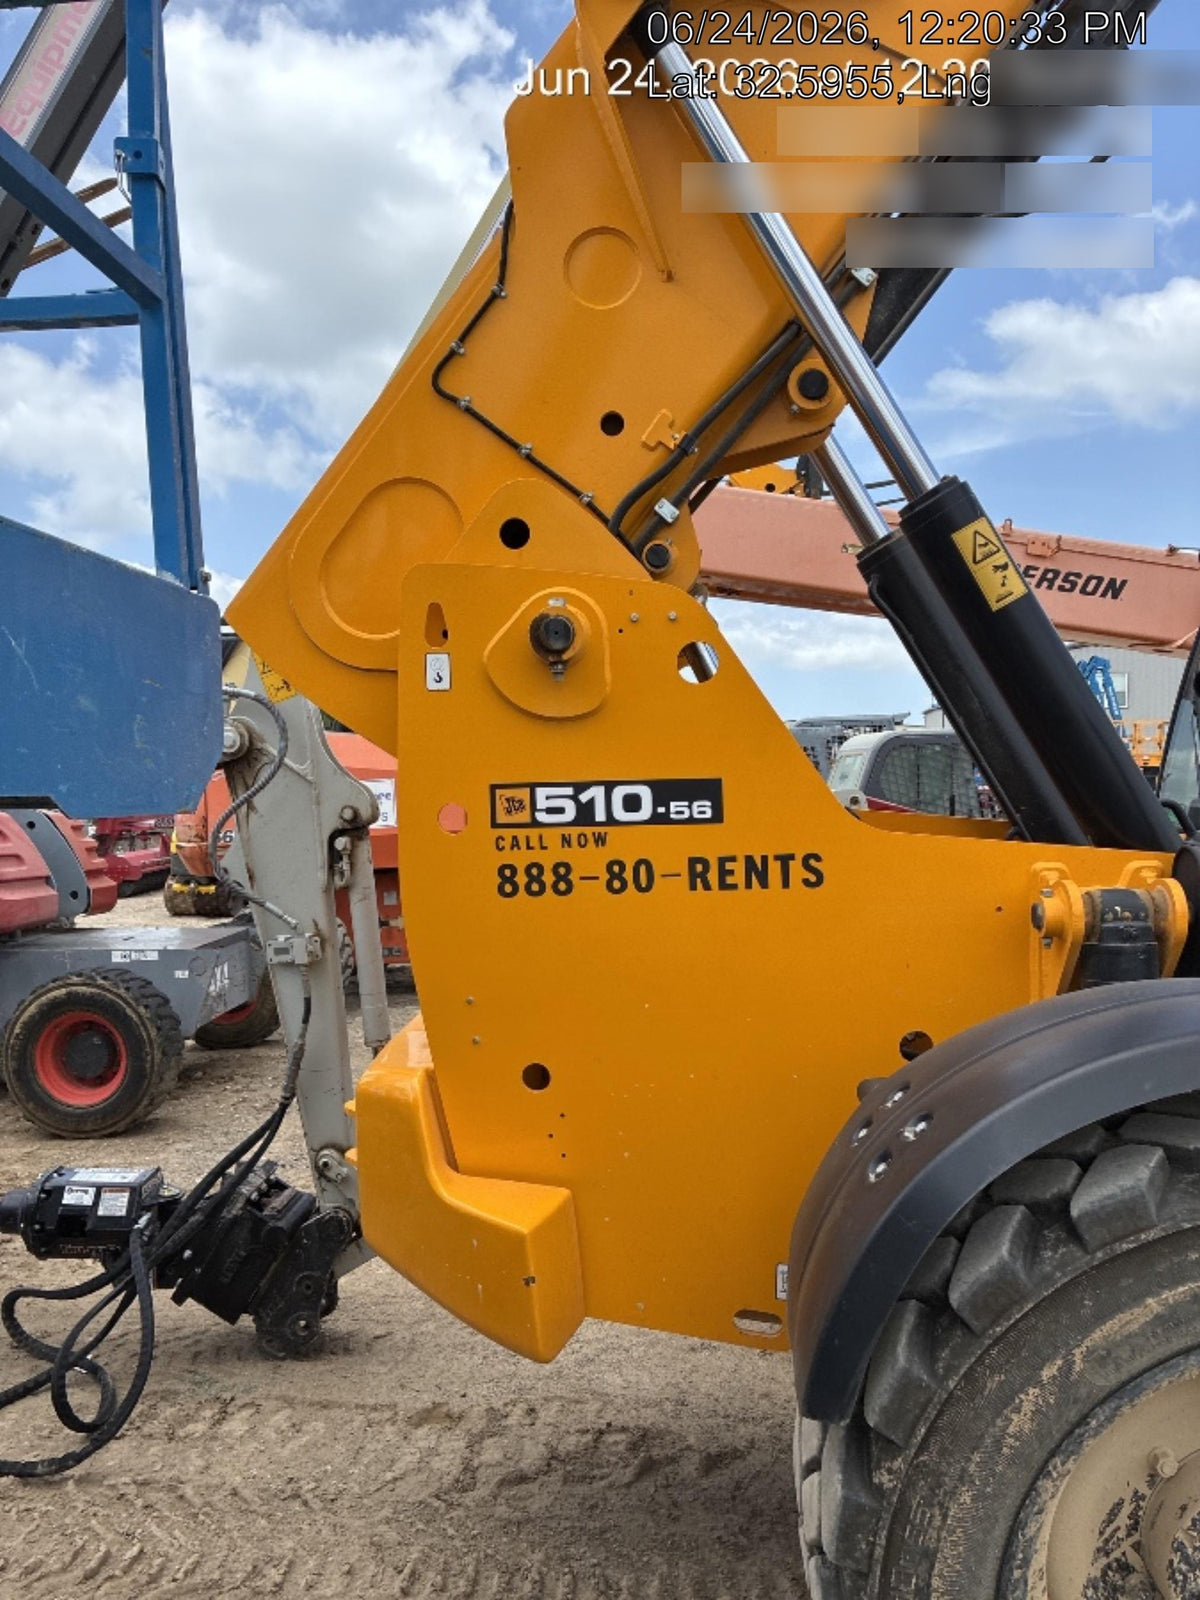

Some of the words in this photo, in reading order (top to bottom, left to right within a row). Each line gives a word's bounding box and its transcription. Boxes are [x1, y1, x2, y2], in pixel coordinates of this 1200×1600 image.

[1017, 563, 1128, 600] ERSON
[495, 835, 548, 852] CALL
[561, 832, 608, 849] NOW
[497, 853, 825, 898] 888-80-RENTS
